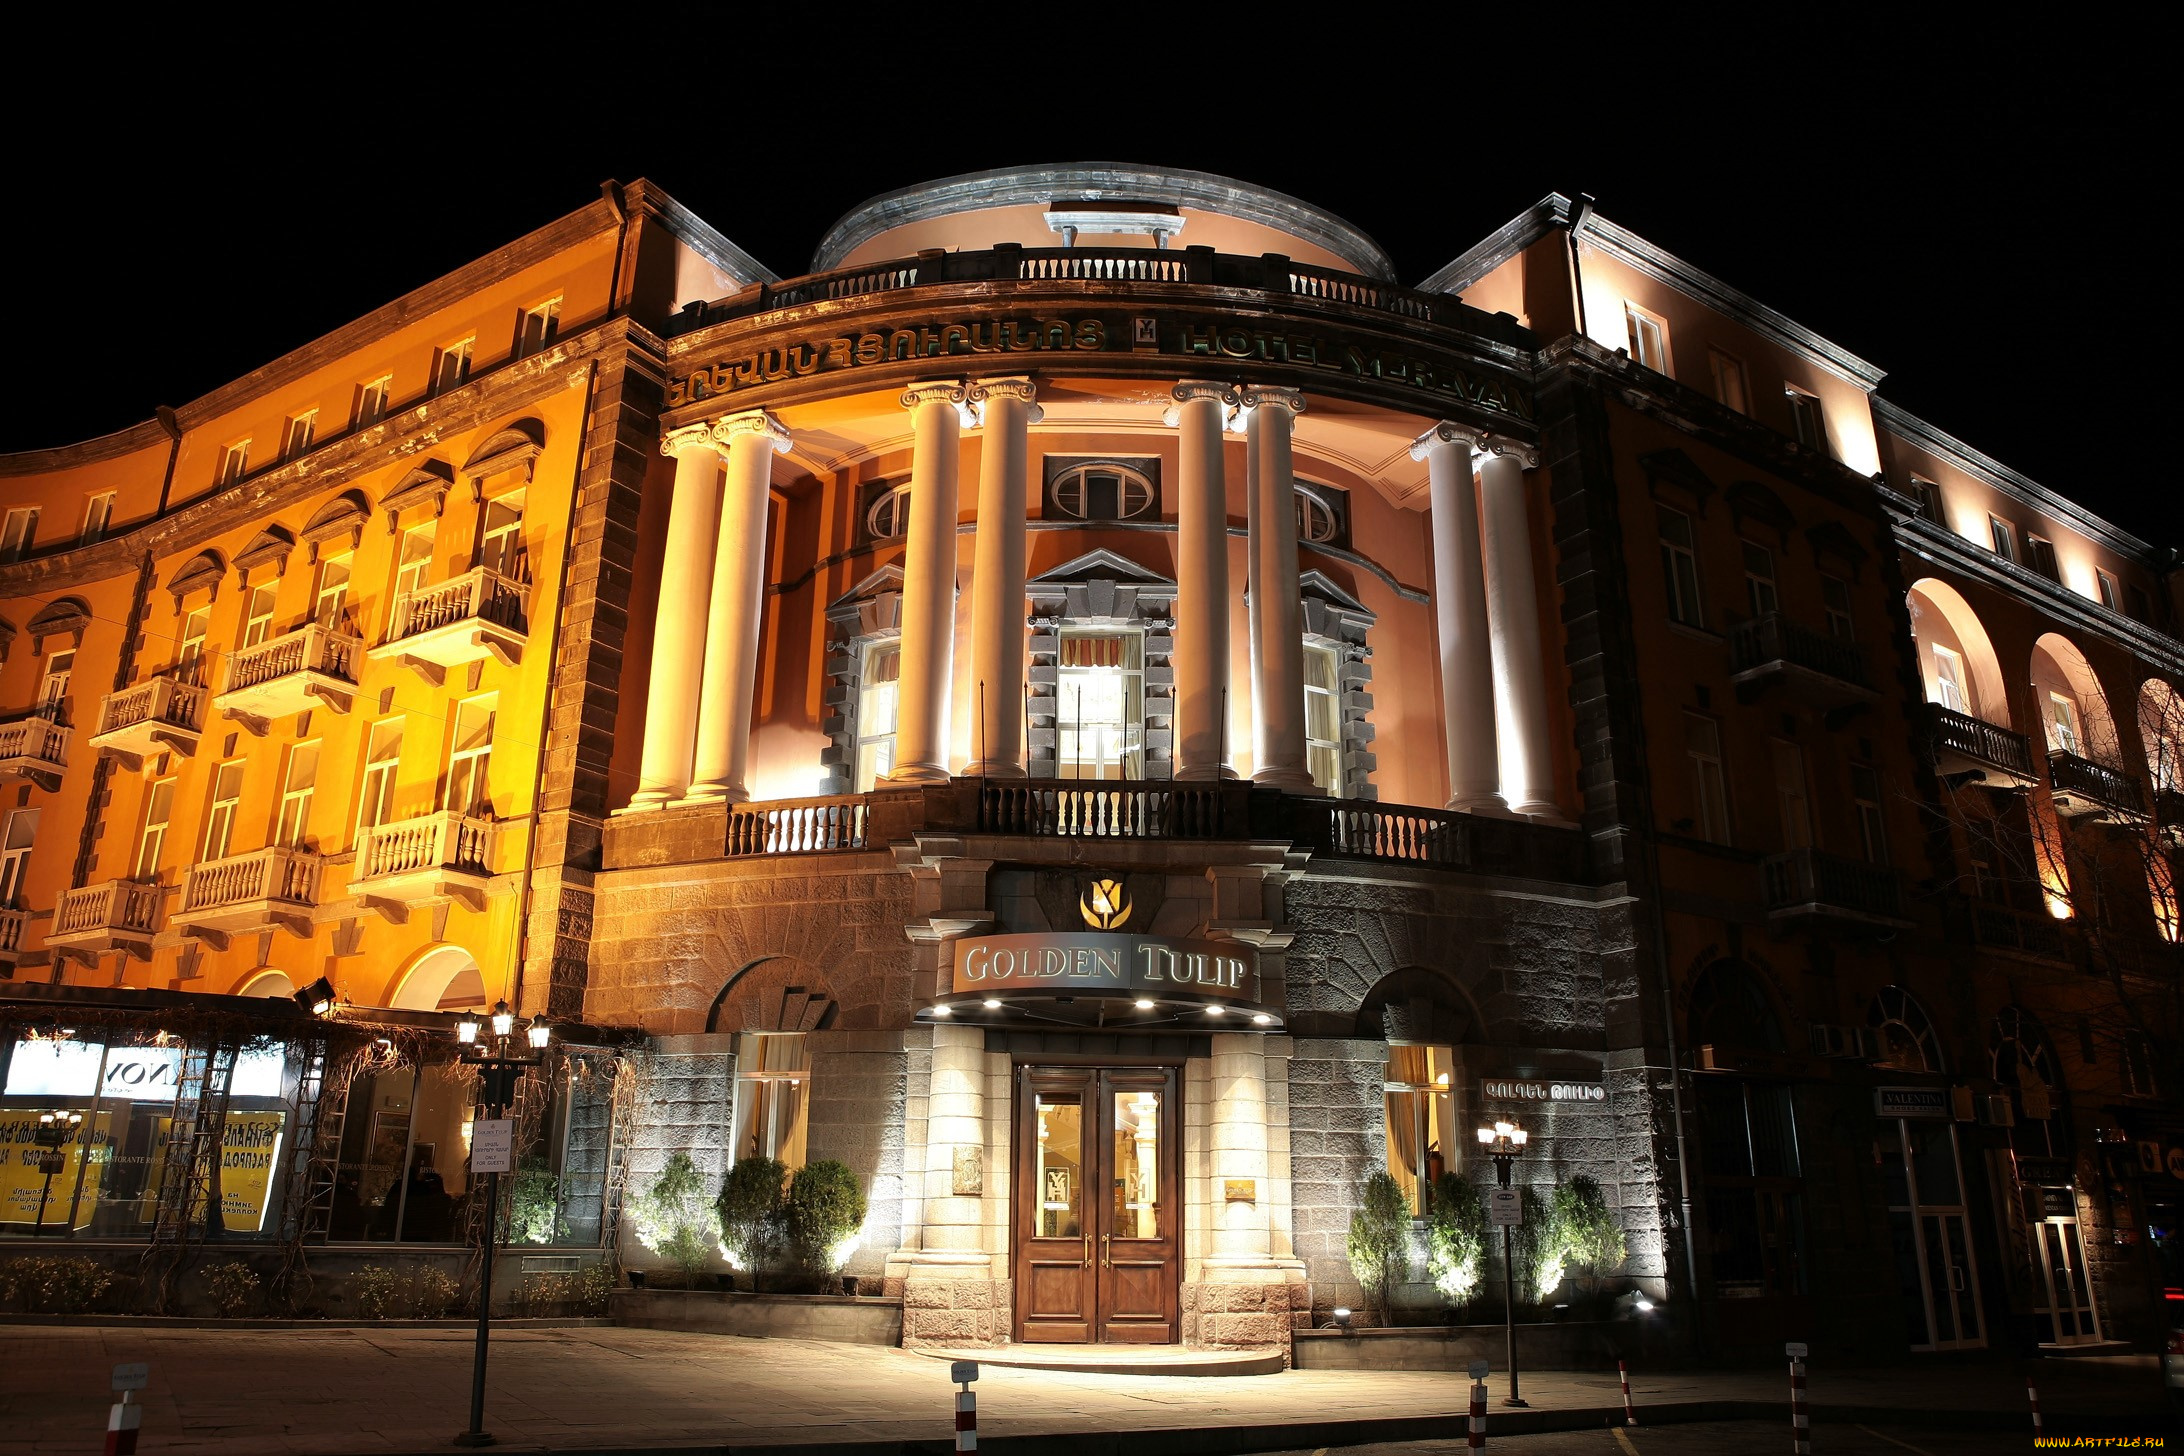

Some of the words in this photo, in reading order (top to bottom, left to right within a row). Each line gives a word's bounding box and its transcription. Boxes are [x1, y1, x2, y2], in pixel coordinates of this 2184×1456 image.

[666, 343, 819, 406] ԵՐԵՎԱՆ
[830, 318, 1106, 368] ՀՅՈՒՐԱՆՈՑ
[1184, 324, 1342, 370] HOTEL
[1346, 344, 1534, 421] YEREVAN
[963, 944, 1121, 981] GOLDEN
[1138, 944, 1248, 988] TULIP
